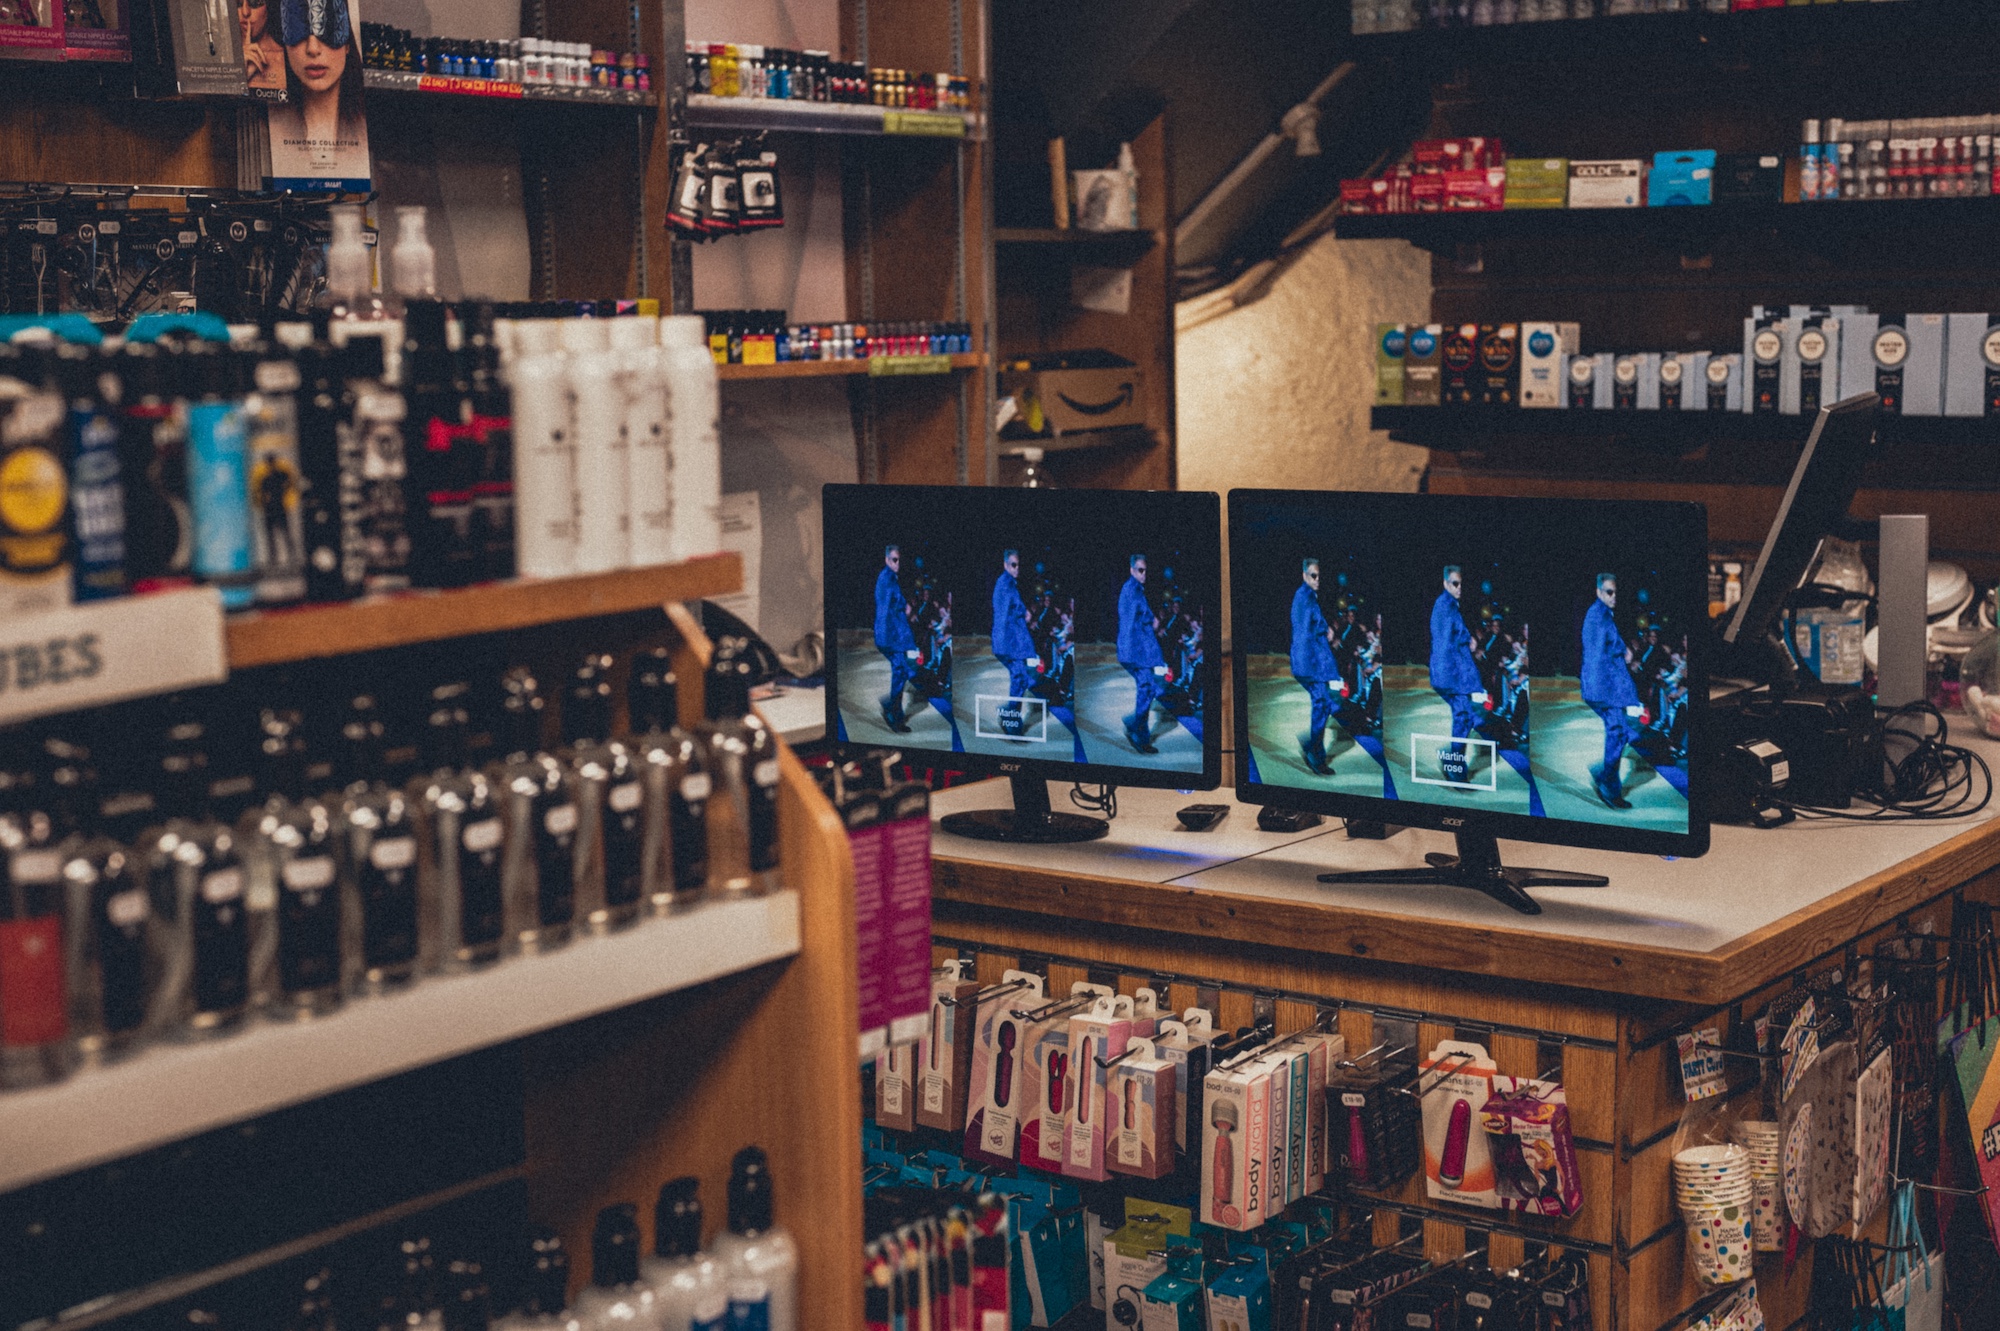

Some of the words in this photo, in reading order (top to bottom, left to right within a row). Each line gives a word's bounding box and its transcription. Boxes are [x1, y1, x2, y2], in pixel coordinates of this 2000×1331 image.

[256, 88, 277, 98] Ouch!
[1002, 720, 1019, 728] rose
[1000, 763, 1021, 771] acer
[1444, 763, 1463, 773] rose
[1442, 817, 1465, 826] acer
[1719, 1231, 1742, 1239] FUCKING
